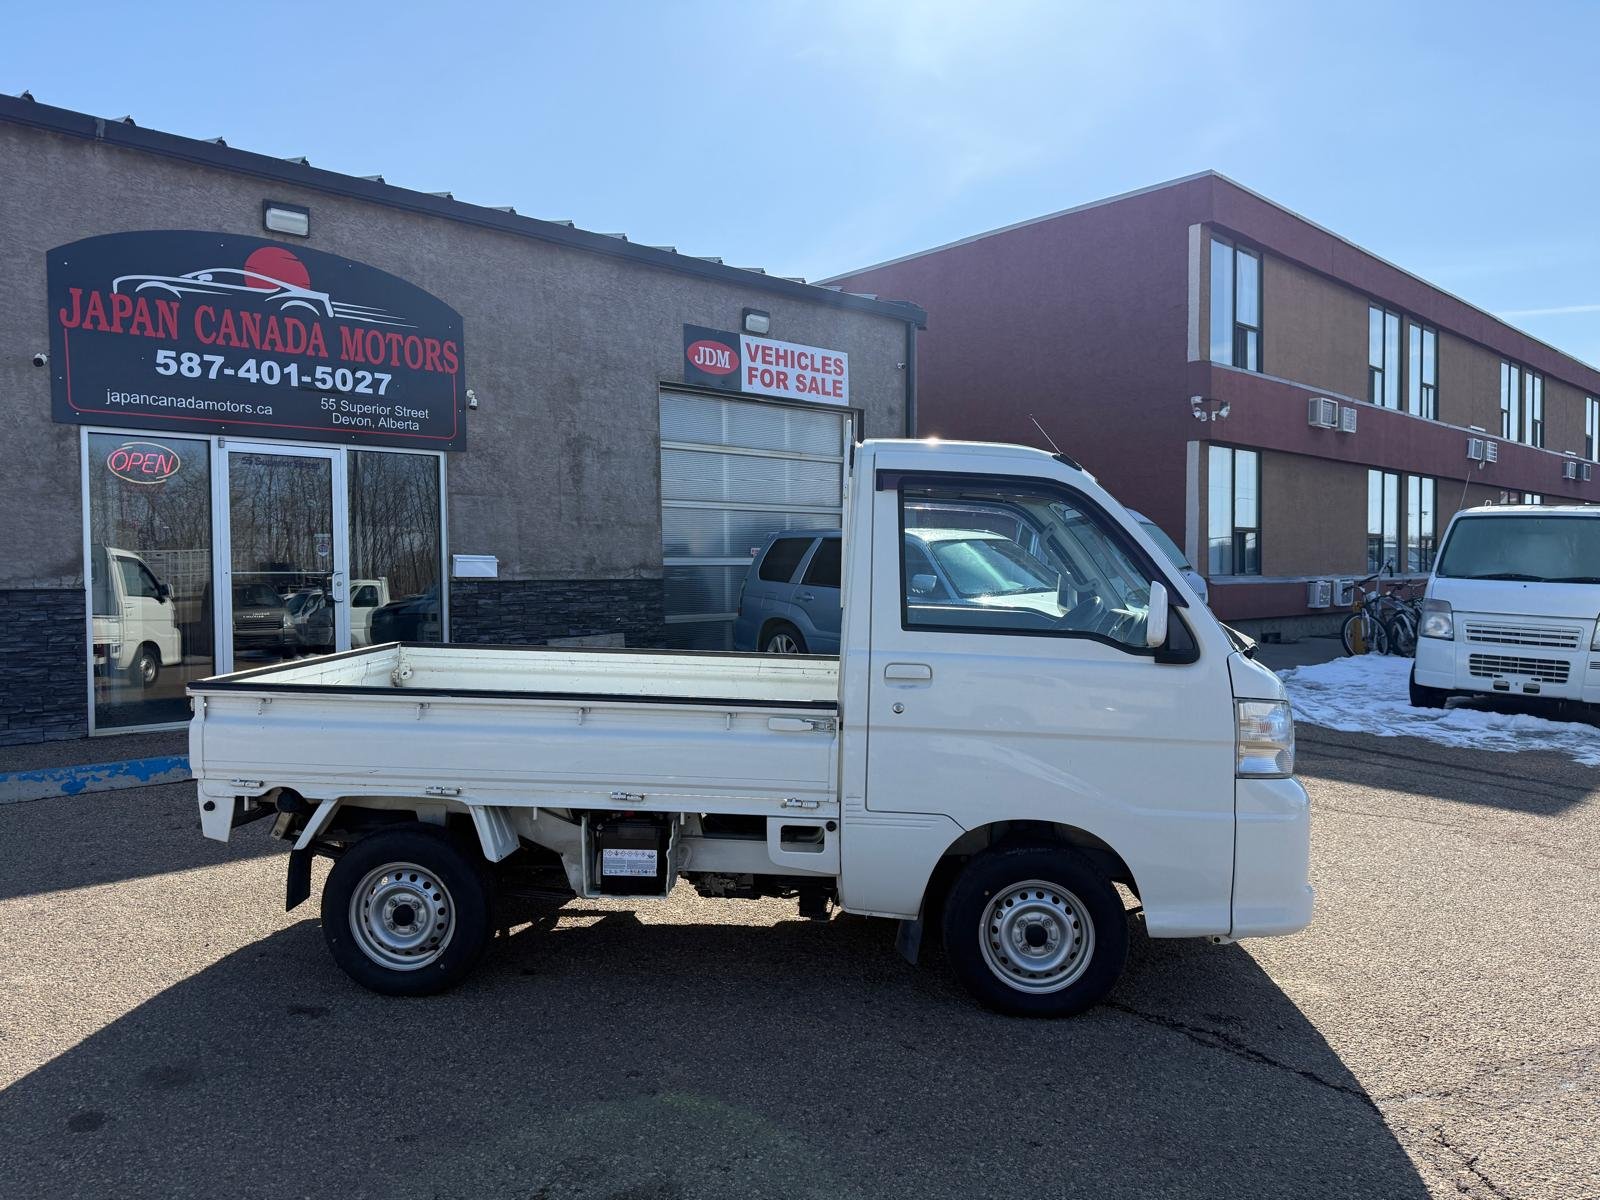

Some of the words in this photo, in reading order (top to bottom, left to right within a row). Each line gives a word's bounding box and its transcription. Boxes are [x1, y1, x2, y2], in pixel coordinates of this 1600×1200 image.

[59, 287, 180, 340] JAPAN
[194, 305, 328, 358] CANADA
[340, 326, 459, 374] MOTORS
[694, 346, 731, 369] JDM
[745, 342, 844, 376] VEHICLES
[155, 349, 392, 396] 587-401-5027
[747, 366, 789, 391] FOR
[795, 373, 843, 398] SALE
[106, 388, 273, 415] japancanadamotors.ca
[320, 398, 336, 411] 55
[340, 400, 391, 418] Superior
[394, 405, 430, 419] Street
[332, 413, 375, 428] Devon,
[378, 417, 420, 431] Alberta
[111, 451, 174, 474] OPEN
